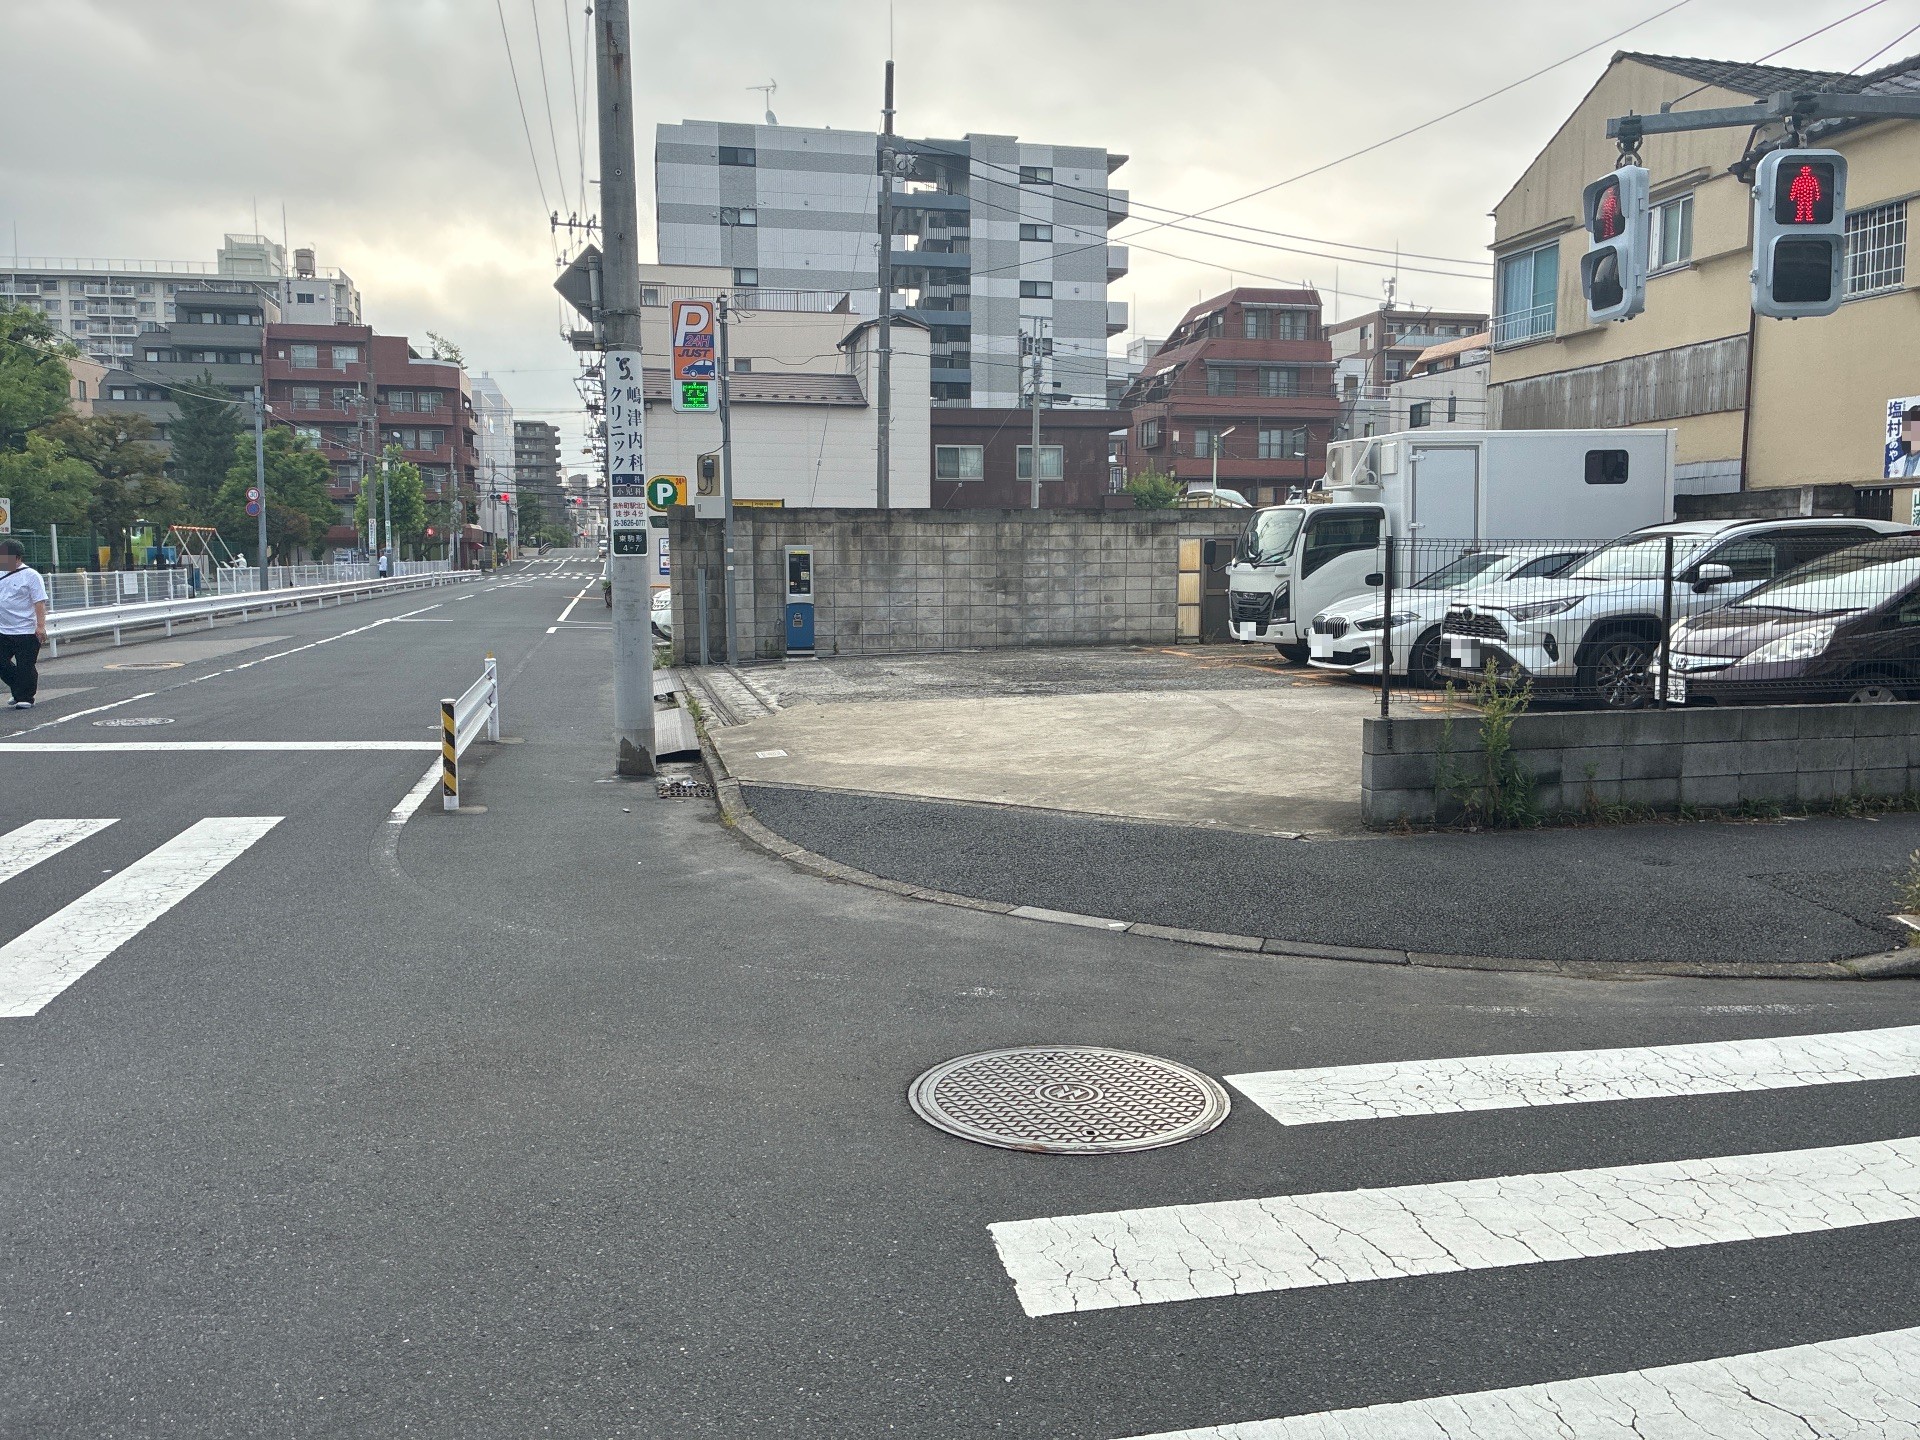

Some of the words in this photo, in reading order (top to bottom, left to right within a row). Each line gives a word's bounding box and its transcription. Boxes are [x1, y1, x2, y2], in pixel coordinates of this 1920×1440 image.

[674, 304, 710, 347] P
[684, 334, 711, 347] 24H
[678, 348, 711, 358] JUST
[610, 386, 626, 471] クリニック
[626, 386, 644, 472] 嶋津内科
[616, 487, 641, 496] 小児科
[656, 482, 674, 505] P
[615, 510, 644, 518] 徒歩4分
[618, 534, 643, 543] 東駒形
[622, 544, 640, 552] 4-7
